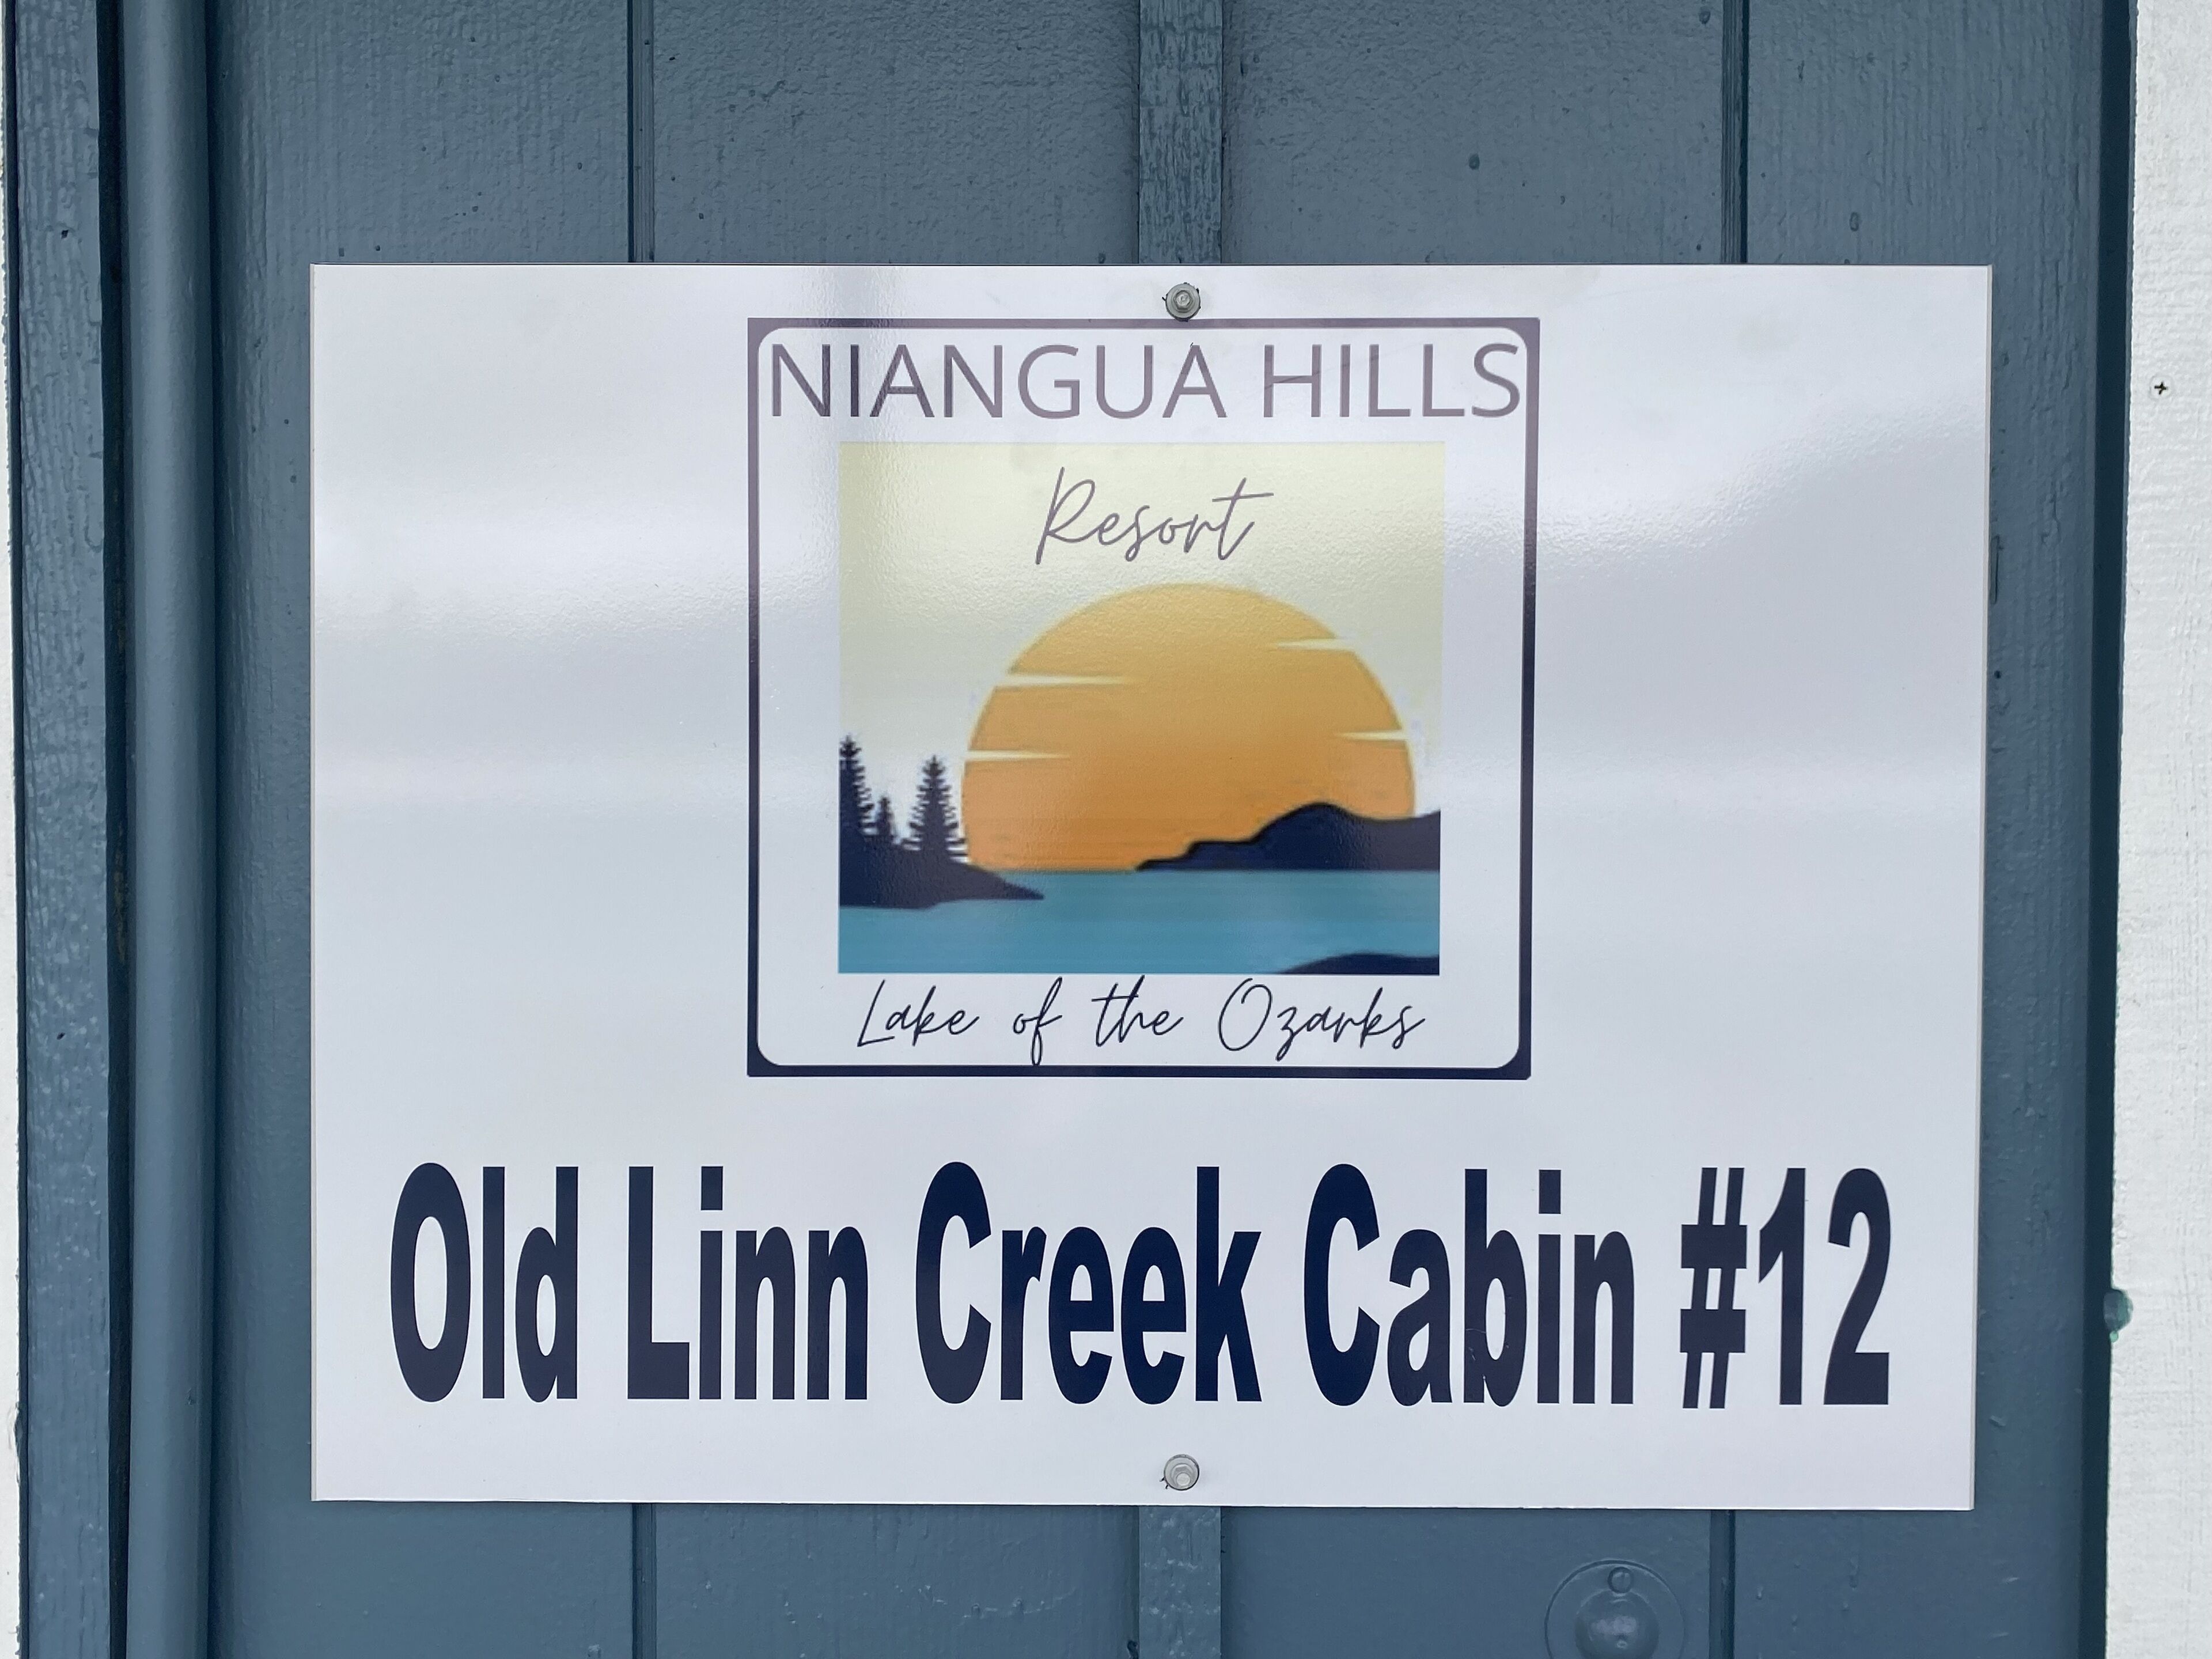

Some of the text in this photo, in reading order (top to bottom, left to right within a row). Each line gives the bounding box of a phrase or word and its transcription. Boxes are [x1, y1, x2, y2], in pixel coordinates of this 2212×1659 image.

[771, 342, 1520, 419] NIANGUA HILLS
[1035, 467, 1274, 565] Resort
[857, 976, 1426, 1064] Lake of the Ozarks
[391, 1162, 1891, 1408] Old Linn Creek Cabin #12
